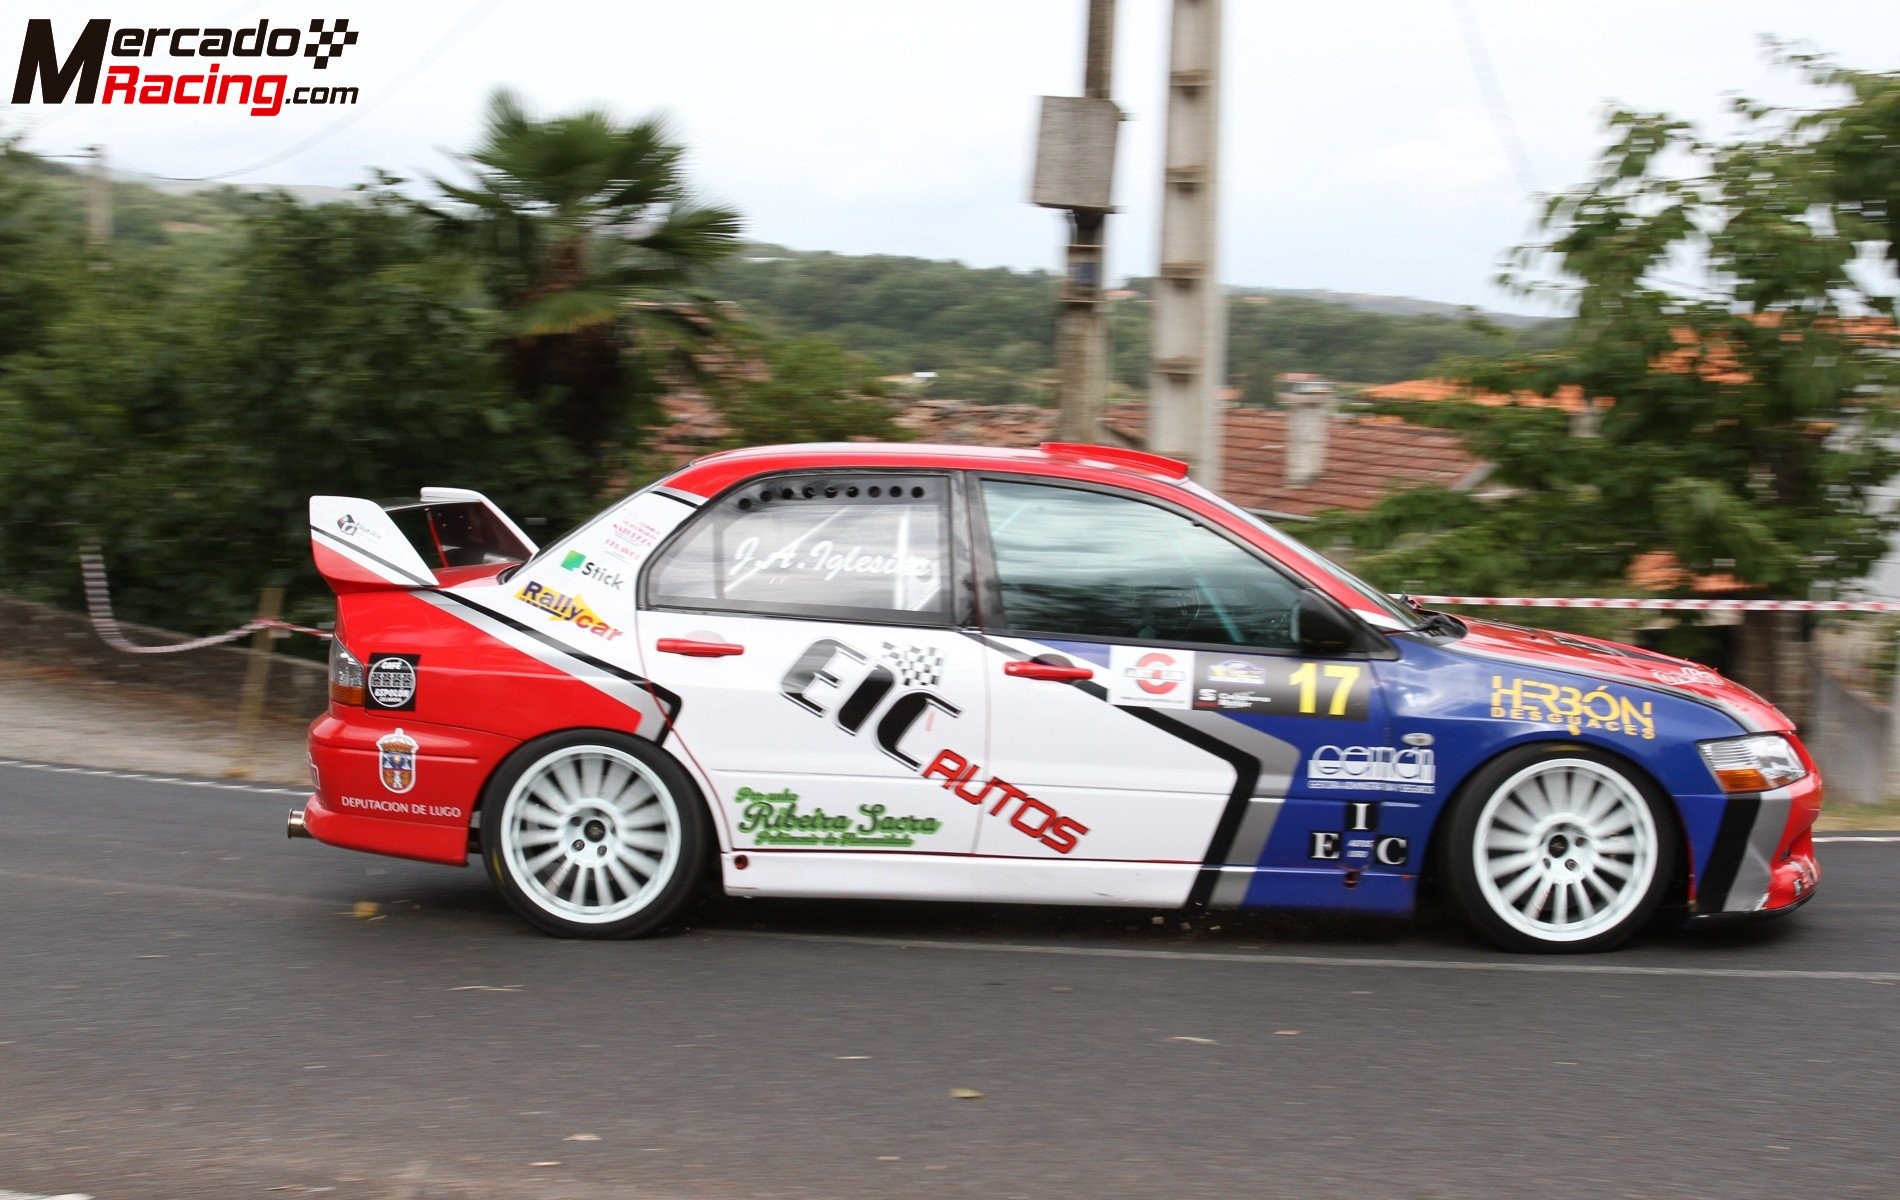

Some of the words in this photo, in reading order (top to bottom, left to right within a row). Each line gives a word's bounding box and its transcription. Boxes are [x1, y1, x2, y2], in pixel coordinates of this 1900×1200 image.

[581, 562, 624, 591] Stick
[522, 580, 625, 641] Rallycar
[1288, 662, 1361, 716] 17
[1490, 706, 1656, 740] DESGUACES
[411, 803, 427, 816] DE
[429, 805, 461, 818] LUGO
[738, 801, 853, 832] Ribeira
[857, 804, 941, 834] Sacra
[922, 748, 1090, 854] AUTOS
